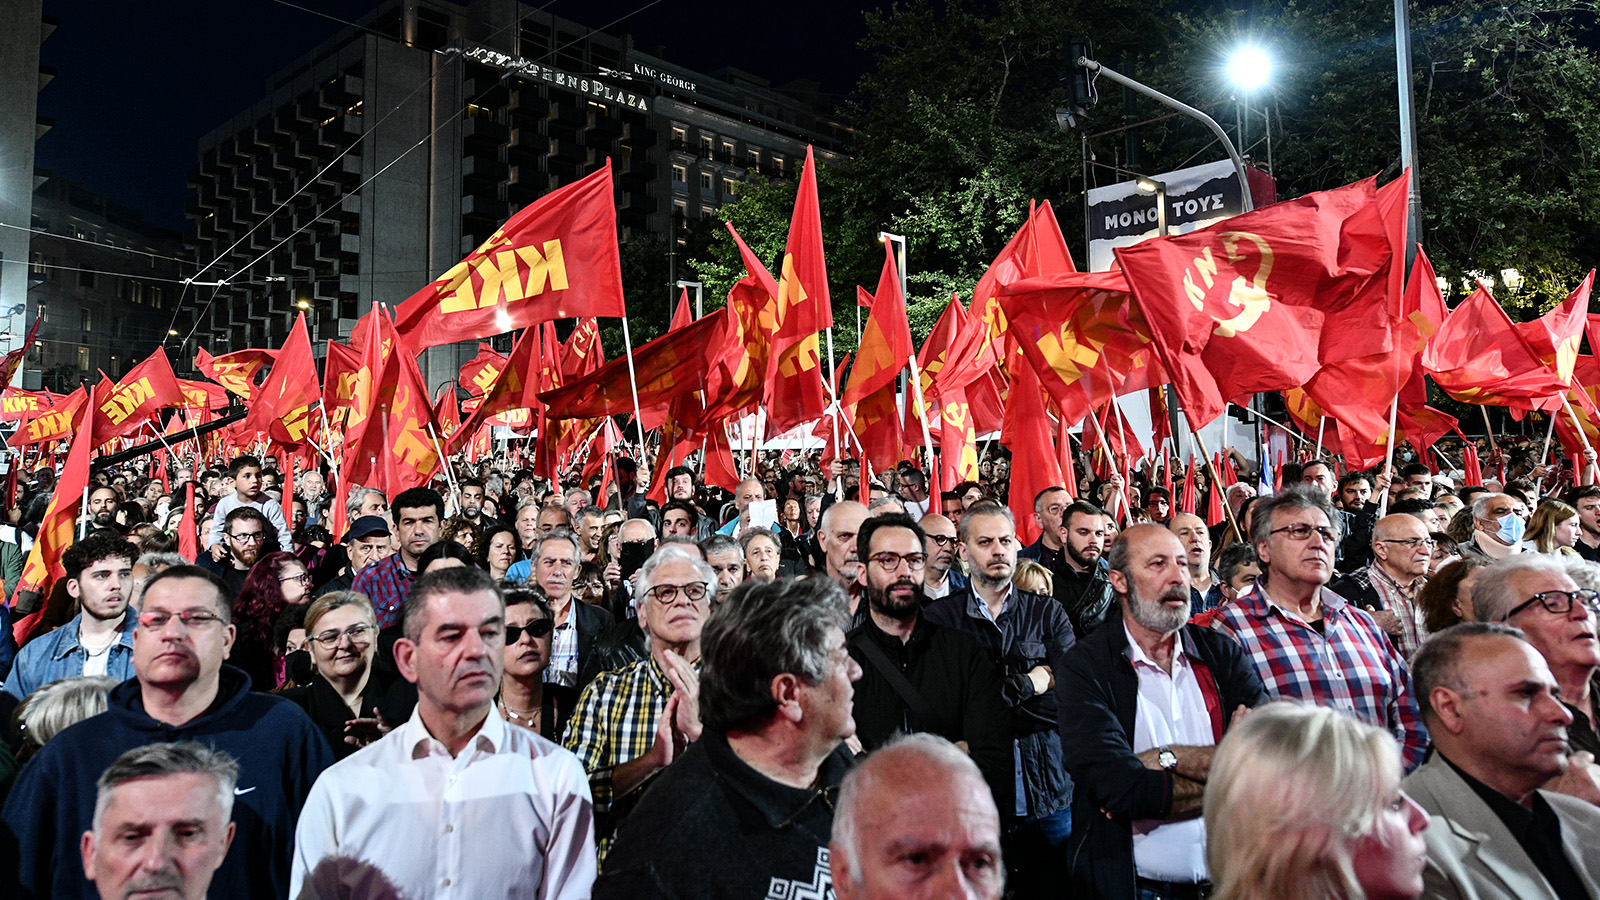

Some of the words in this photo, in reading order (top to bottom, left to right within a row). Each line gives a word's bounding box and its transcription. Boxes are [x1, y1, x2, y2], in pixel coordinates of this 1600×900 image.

[634, 63, 657, 78] KING
[660, 73, 697, 93] GEORGE
[592, 80, 648, 111] PLAZA
[1105, 207, 1159, 231] ΜΟΝΟ
[1172, 193, 1224, 217] ΤΟΥΣ
